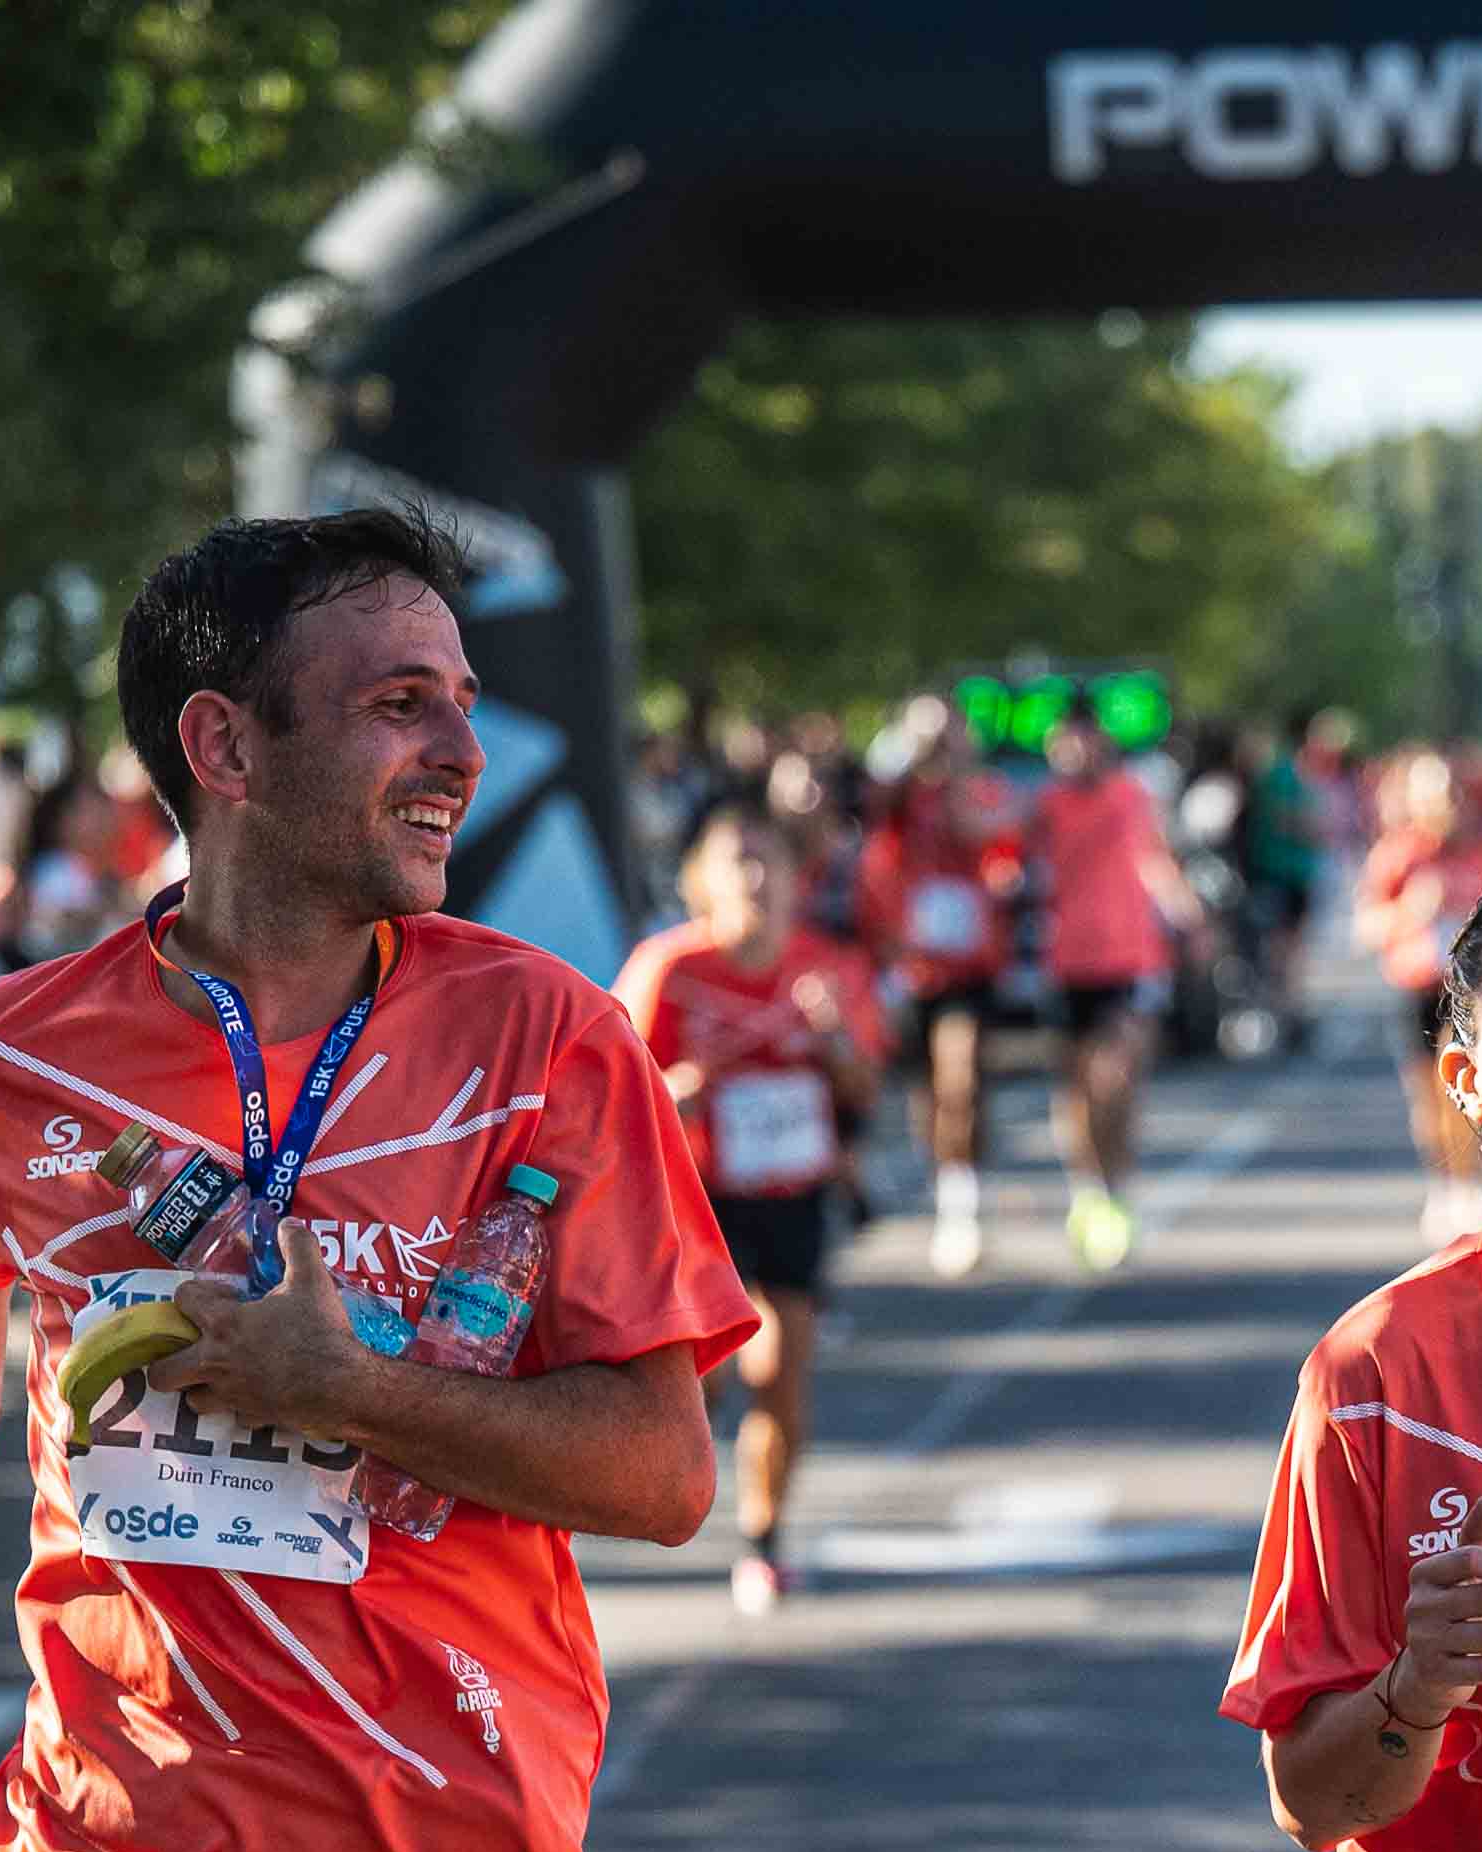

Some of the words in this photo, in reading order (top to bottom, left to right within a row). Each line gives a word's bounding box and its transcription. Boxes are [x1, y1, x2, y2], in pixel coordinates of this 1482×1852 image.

[201, 981, 244, 1036] NORTE
[309, 1066, 335, 1098] 15K
[339, 997, 372, 1037] PUE
[246, 1091, 269, 1159] osde
[145, 1196, 185, 1242] POWER
[306, 1218, 386, 1275] 5K
[158, 1462, 204, 1485] Duin
[210, 1469, 274, 1493] Franco
[104, 1504, 199, 1542] osde
